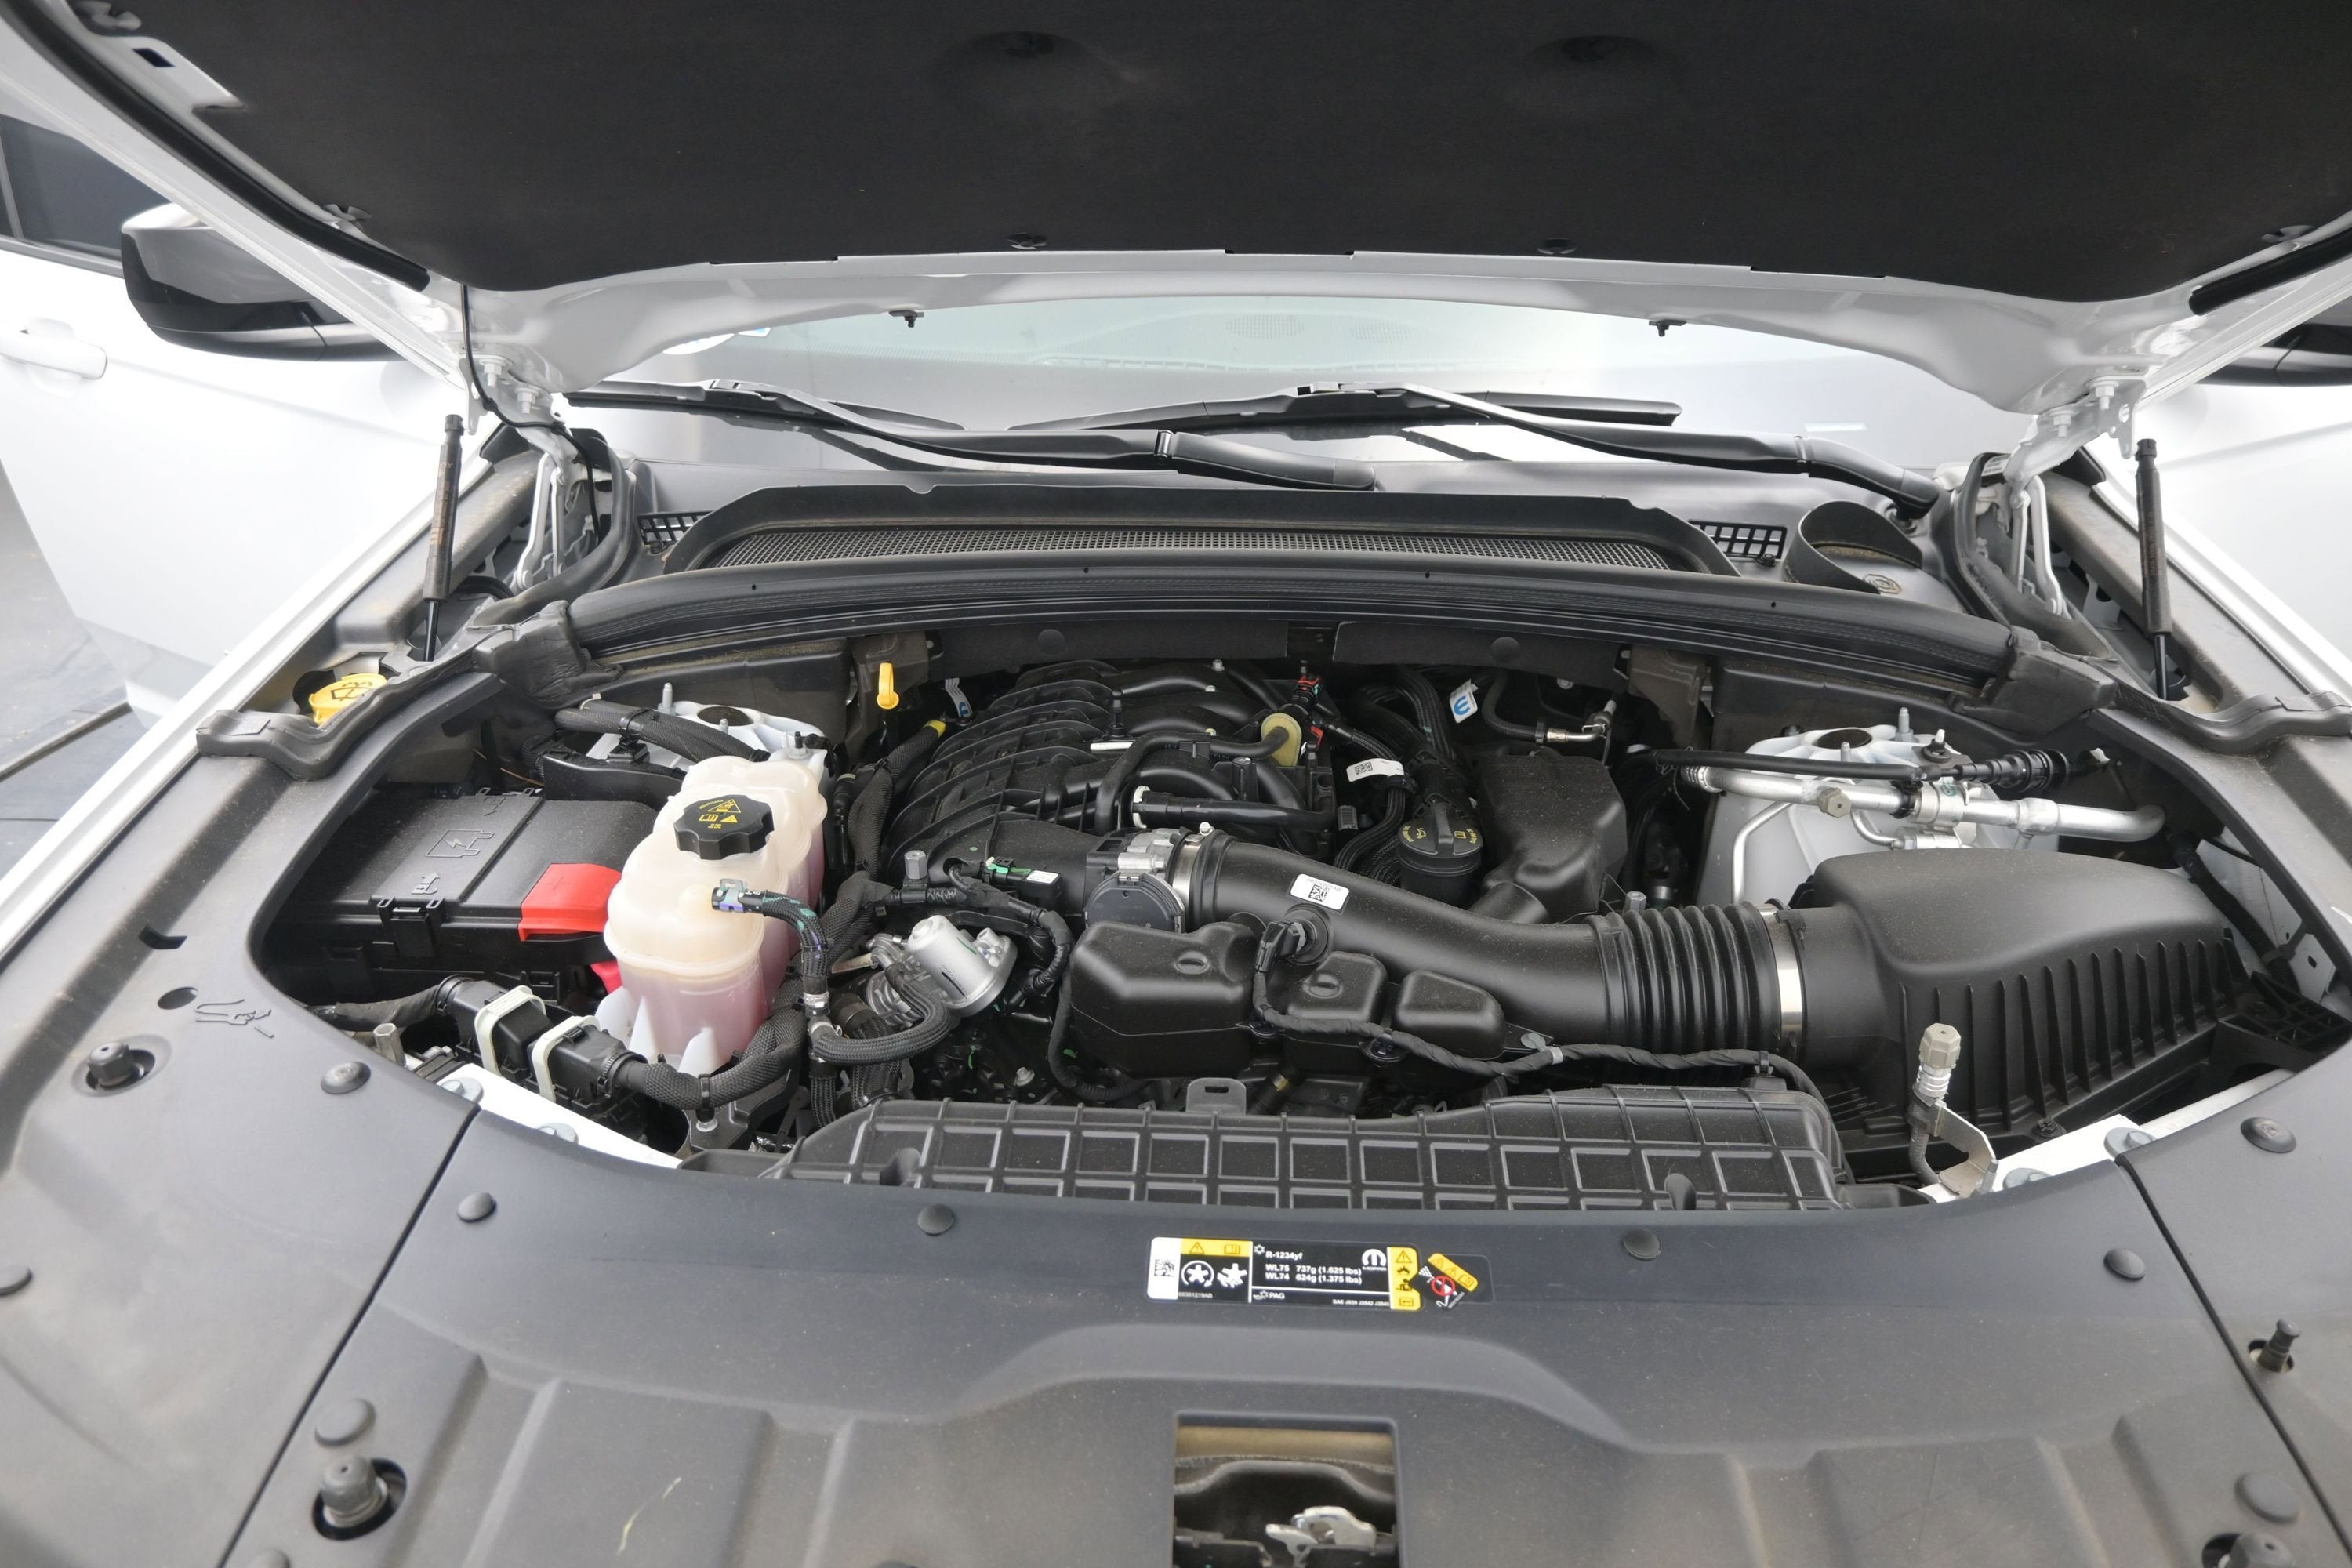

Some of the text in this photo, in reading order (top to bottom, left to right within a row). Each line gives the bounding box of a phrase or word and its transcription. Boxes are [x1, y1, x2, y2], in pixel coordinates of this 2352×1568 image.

[1265, 1250, 1303, 1261] R-1234yf
[1265, 1263, 1362, 1276] WL75 737g (1.625 lbs)
[1265, 1272, 1363, 1285] WL74 624g (1.375 lbs)
